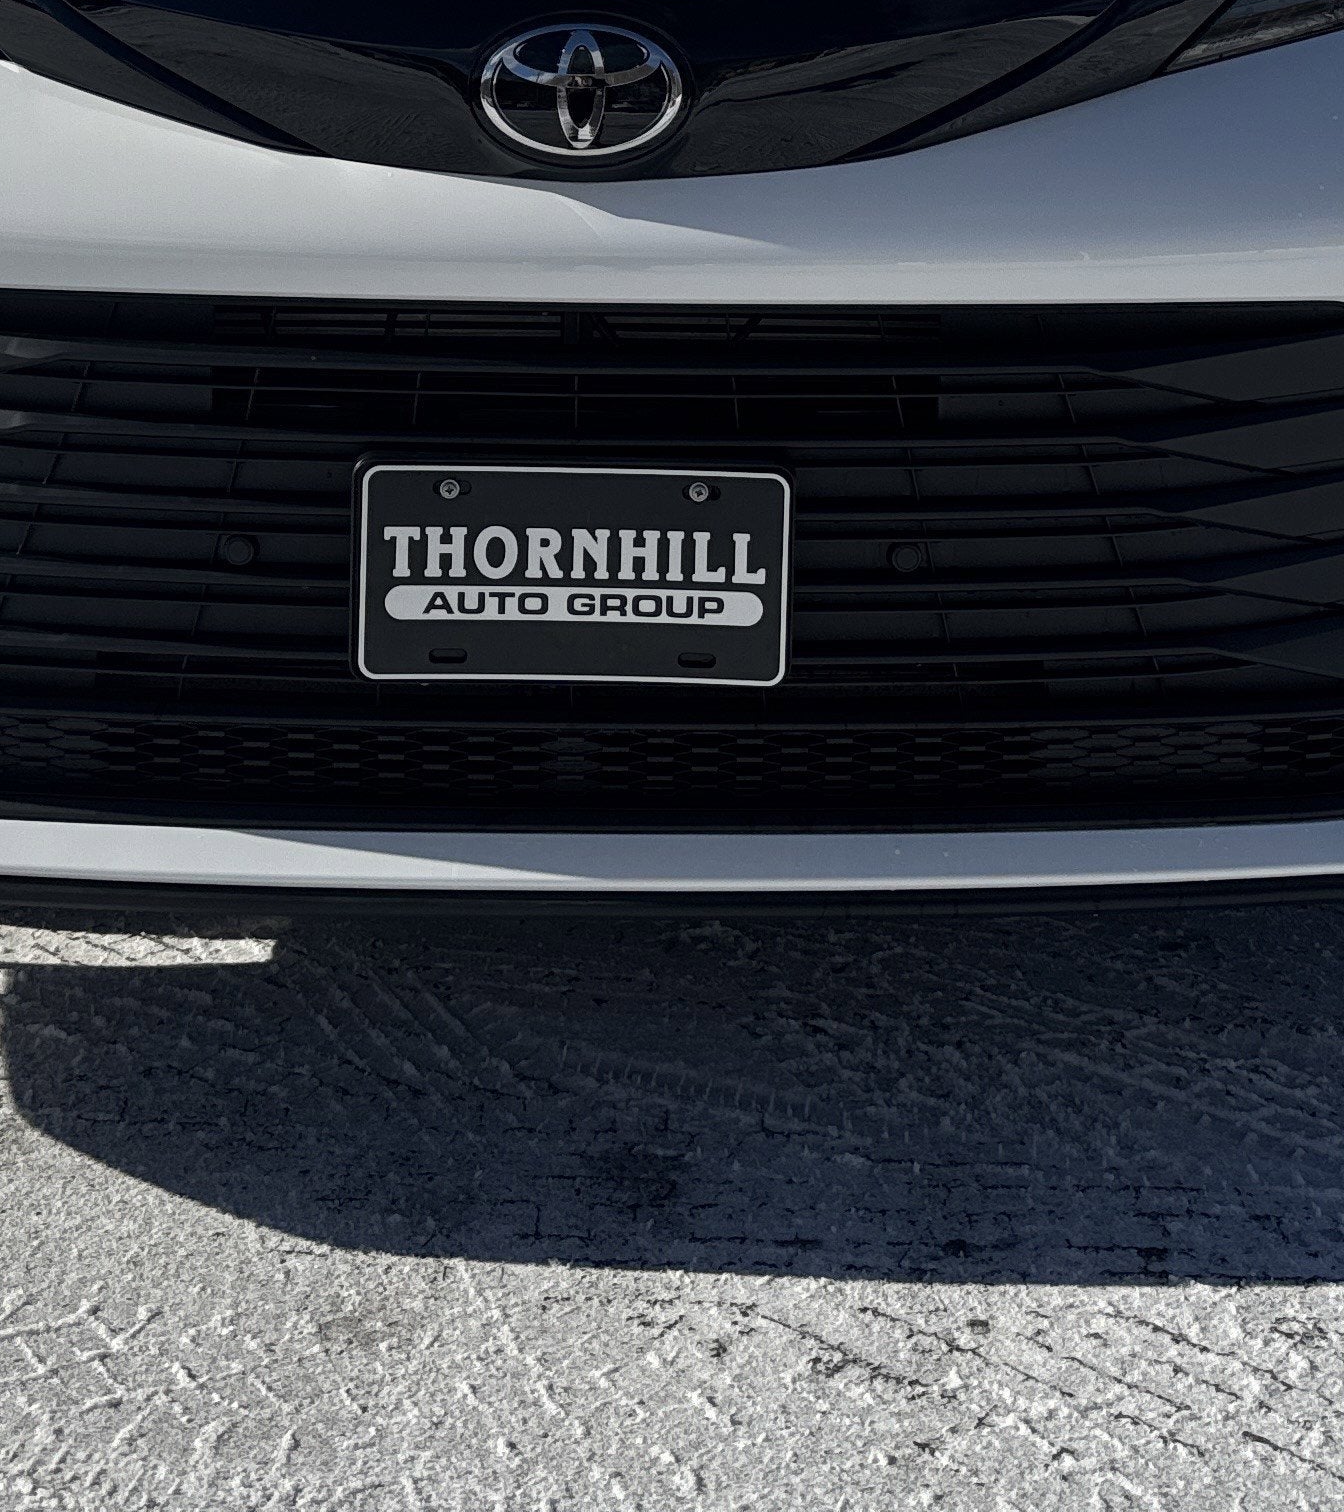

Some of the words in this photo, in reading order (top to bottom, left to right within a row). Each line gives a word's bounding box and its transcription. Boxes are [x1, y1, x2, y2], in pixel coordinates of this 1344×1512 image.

[383, 525, 766, 585] THORNHILL
[422, 591, 549, 615] AUTO
[566, 593, 725, 619] GROUP
